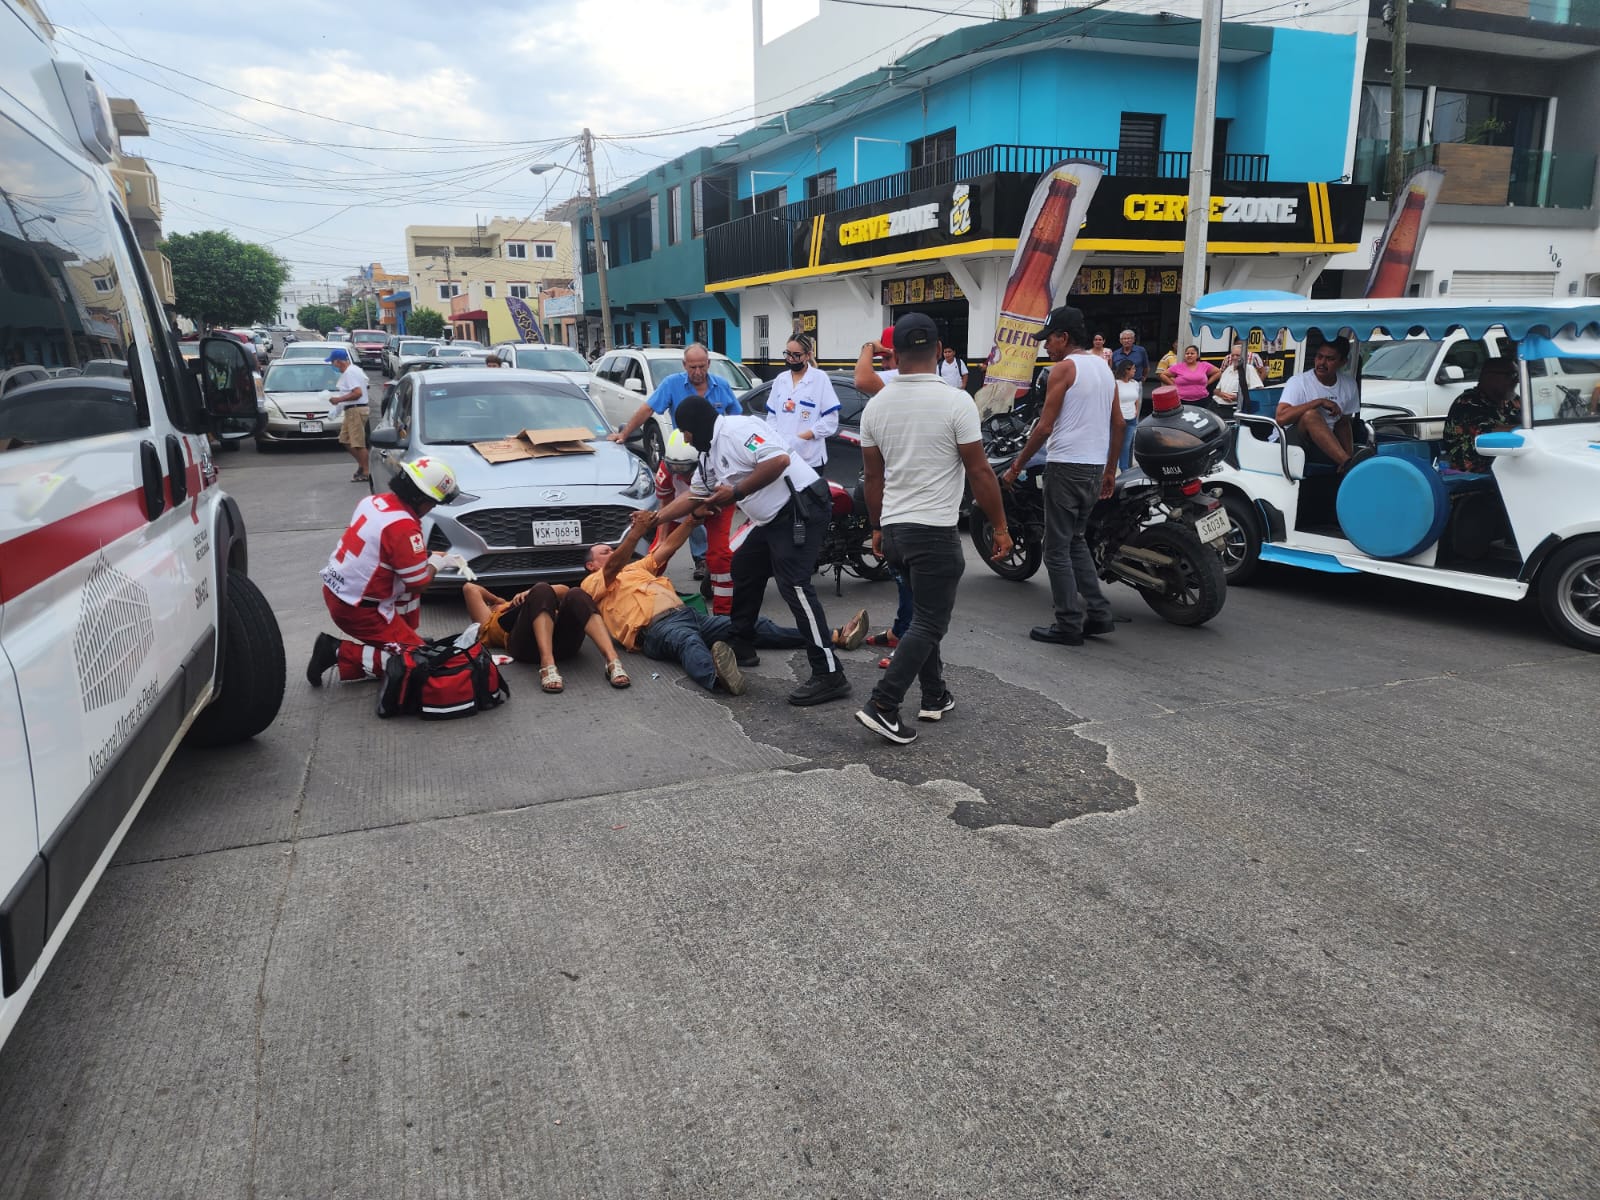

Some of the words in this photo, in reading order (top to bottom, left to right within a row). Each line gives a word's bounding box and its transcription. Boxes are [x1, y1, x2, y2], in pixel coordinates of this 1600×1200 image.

[1124, 194, 1298, 223] CEREZONE
[839, 203, 939, 246] CERVEZONE
[1549, 245, 1562, 268] 106
[1201, 516, 1226, 536] SA03A
